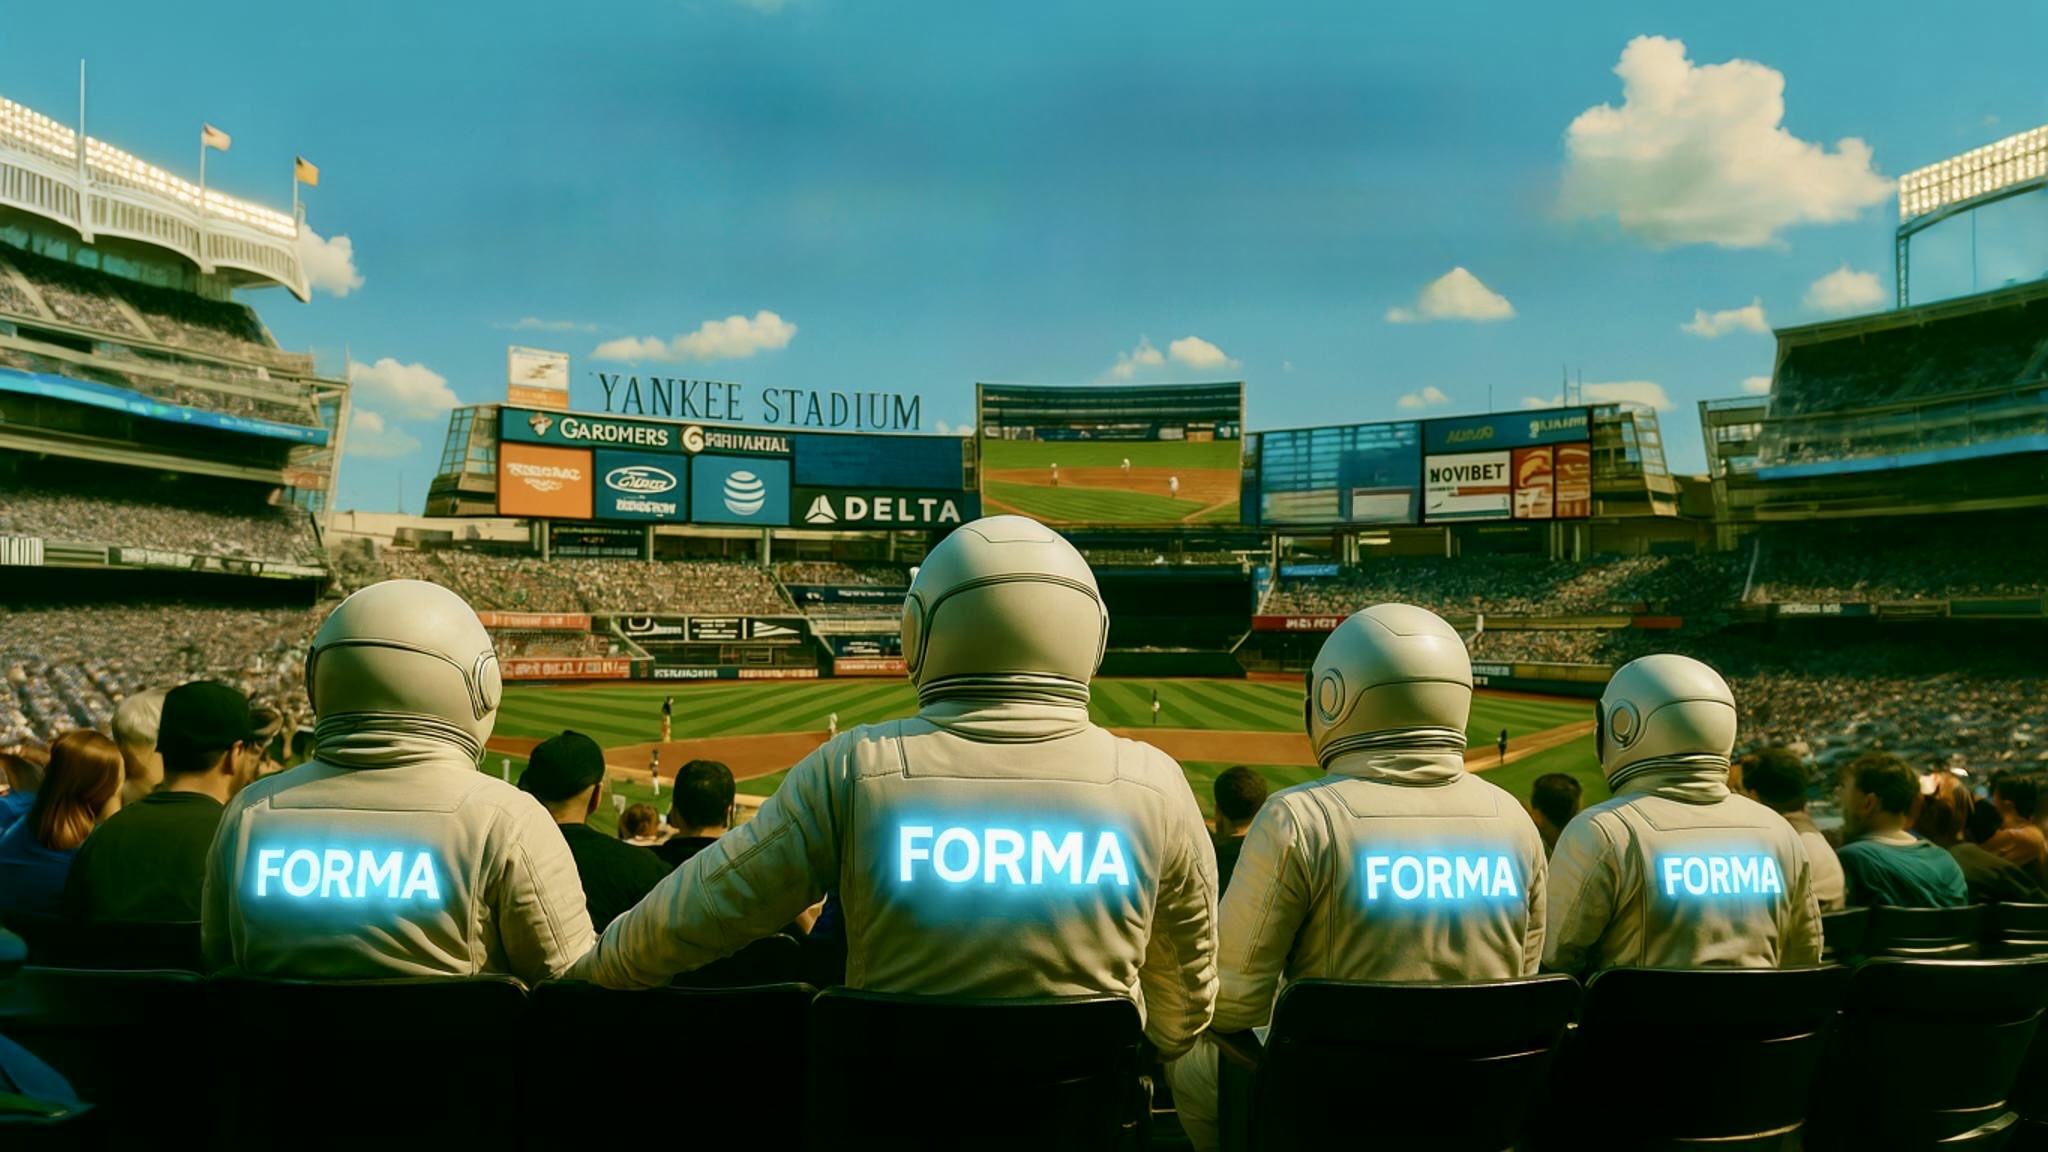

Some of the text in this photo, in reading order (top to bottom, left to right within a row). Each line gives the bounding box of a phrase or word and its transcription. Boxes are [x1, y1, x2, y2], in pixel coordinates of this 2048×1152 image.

[598, 372, 922, 431] YANKEE STADIUM
[1430, 463, 1505, 483] NOVIBET
[844, 496, 961, 523] DELTA
[257, 848, 440, 900] FORMA
[899, 825, 1130, 886] FORMA
[1366, 855, 1519, 900] FORMA
[1663, 856, 1781, 896] FORMA
